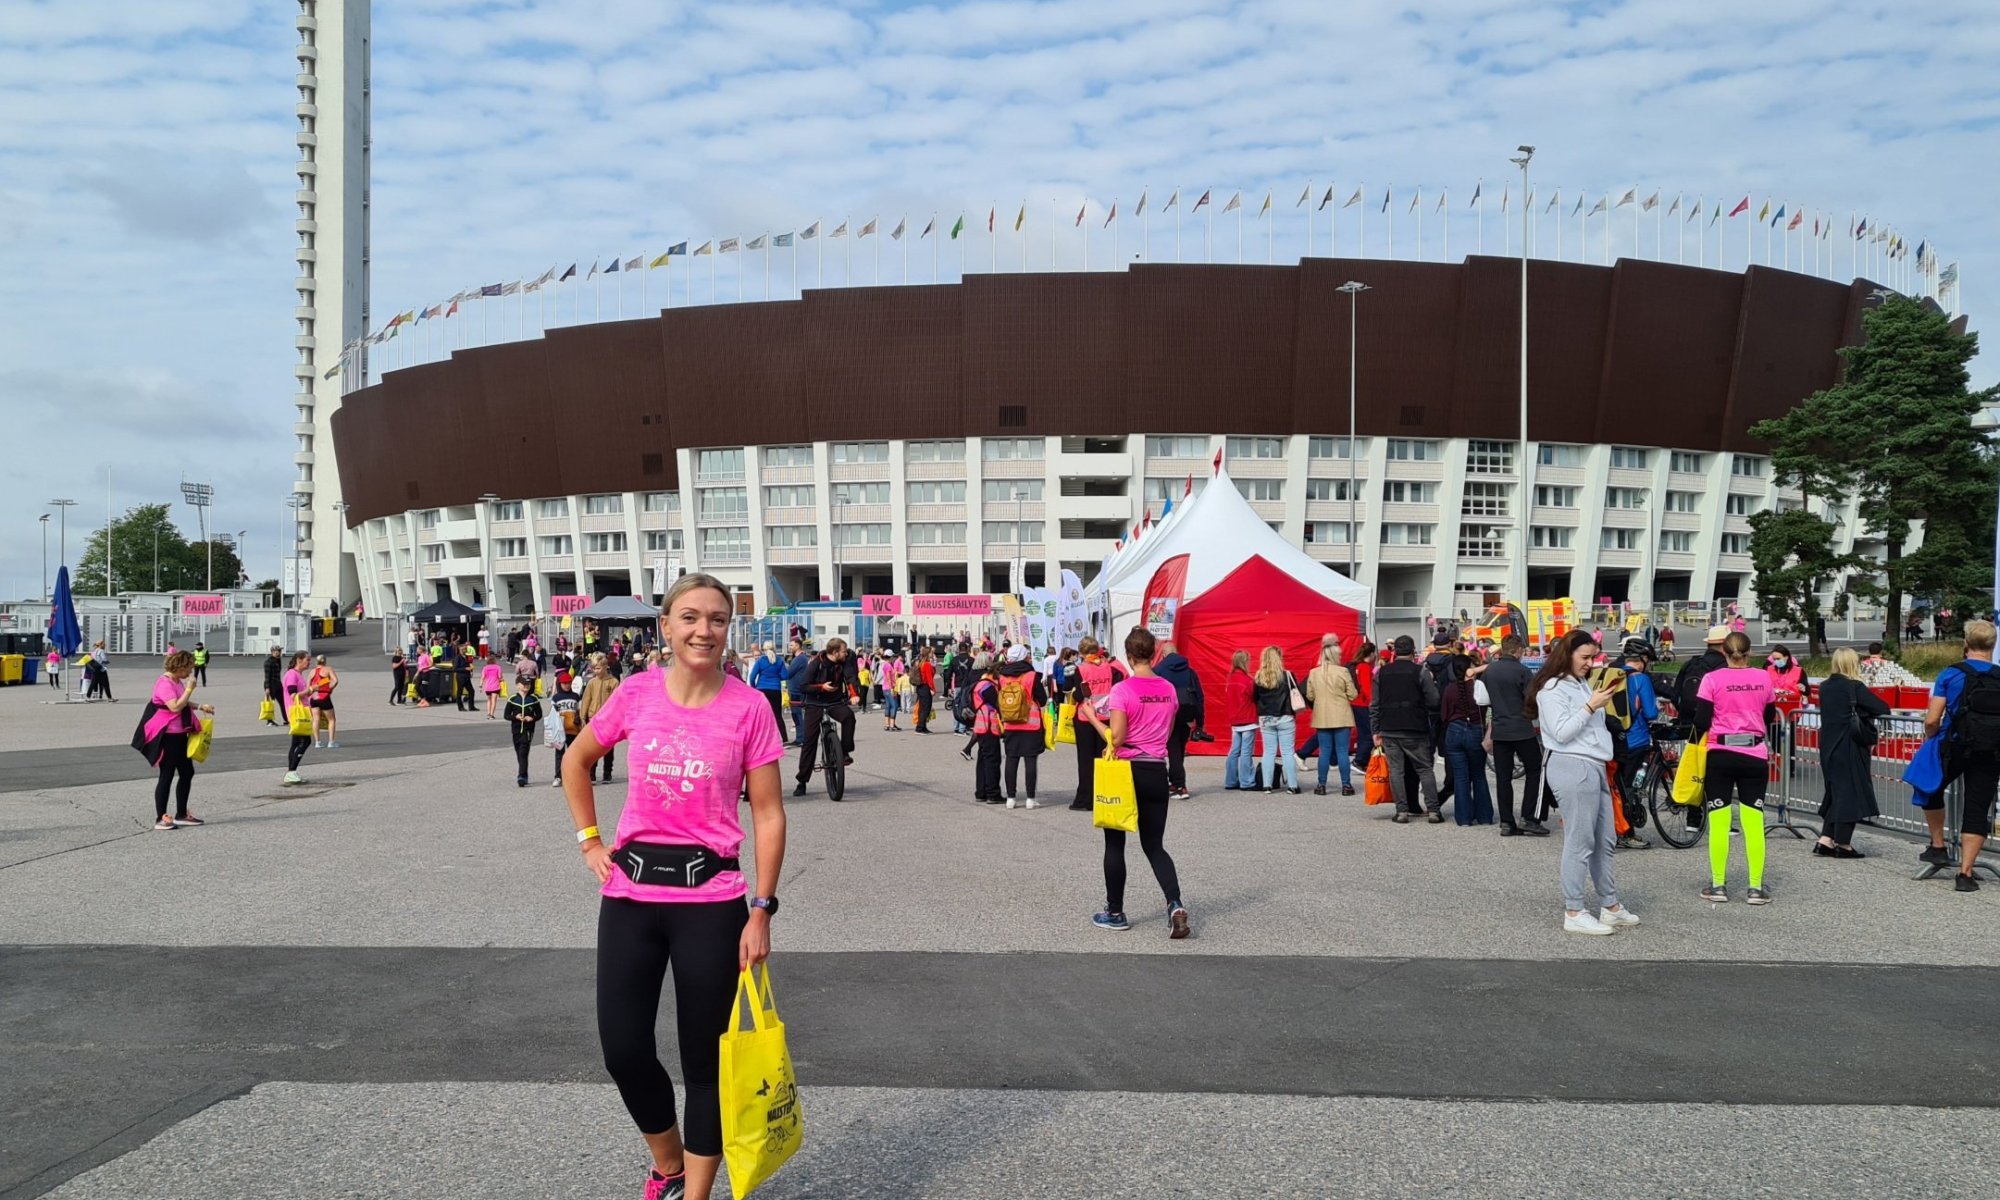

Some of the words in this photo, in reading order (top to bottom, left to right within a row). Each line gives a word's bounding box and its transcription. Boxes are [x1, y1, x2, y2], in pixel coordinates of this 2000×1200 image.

[556, 598, 585, 612] INFO
[872, 598, 892, 611] WC
[915, 598, 988, 609] VARUSTESÄILYTYS
[1726, 684, 1764, 692] stadium
[1139, 694, 1172, 704] stadium
[647, 763, 681, 776] NAISTEN
[683, 759, 704, 778] 10
